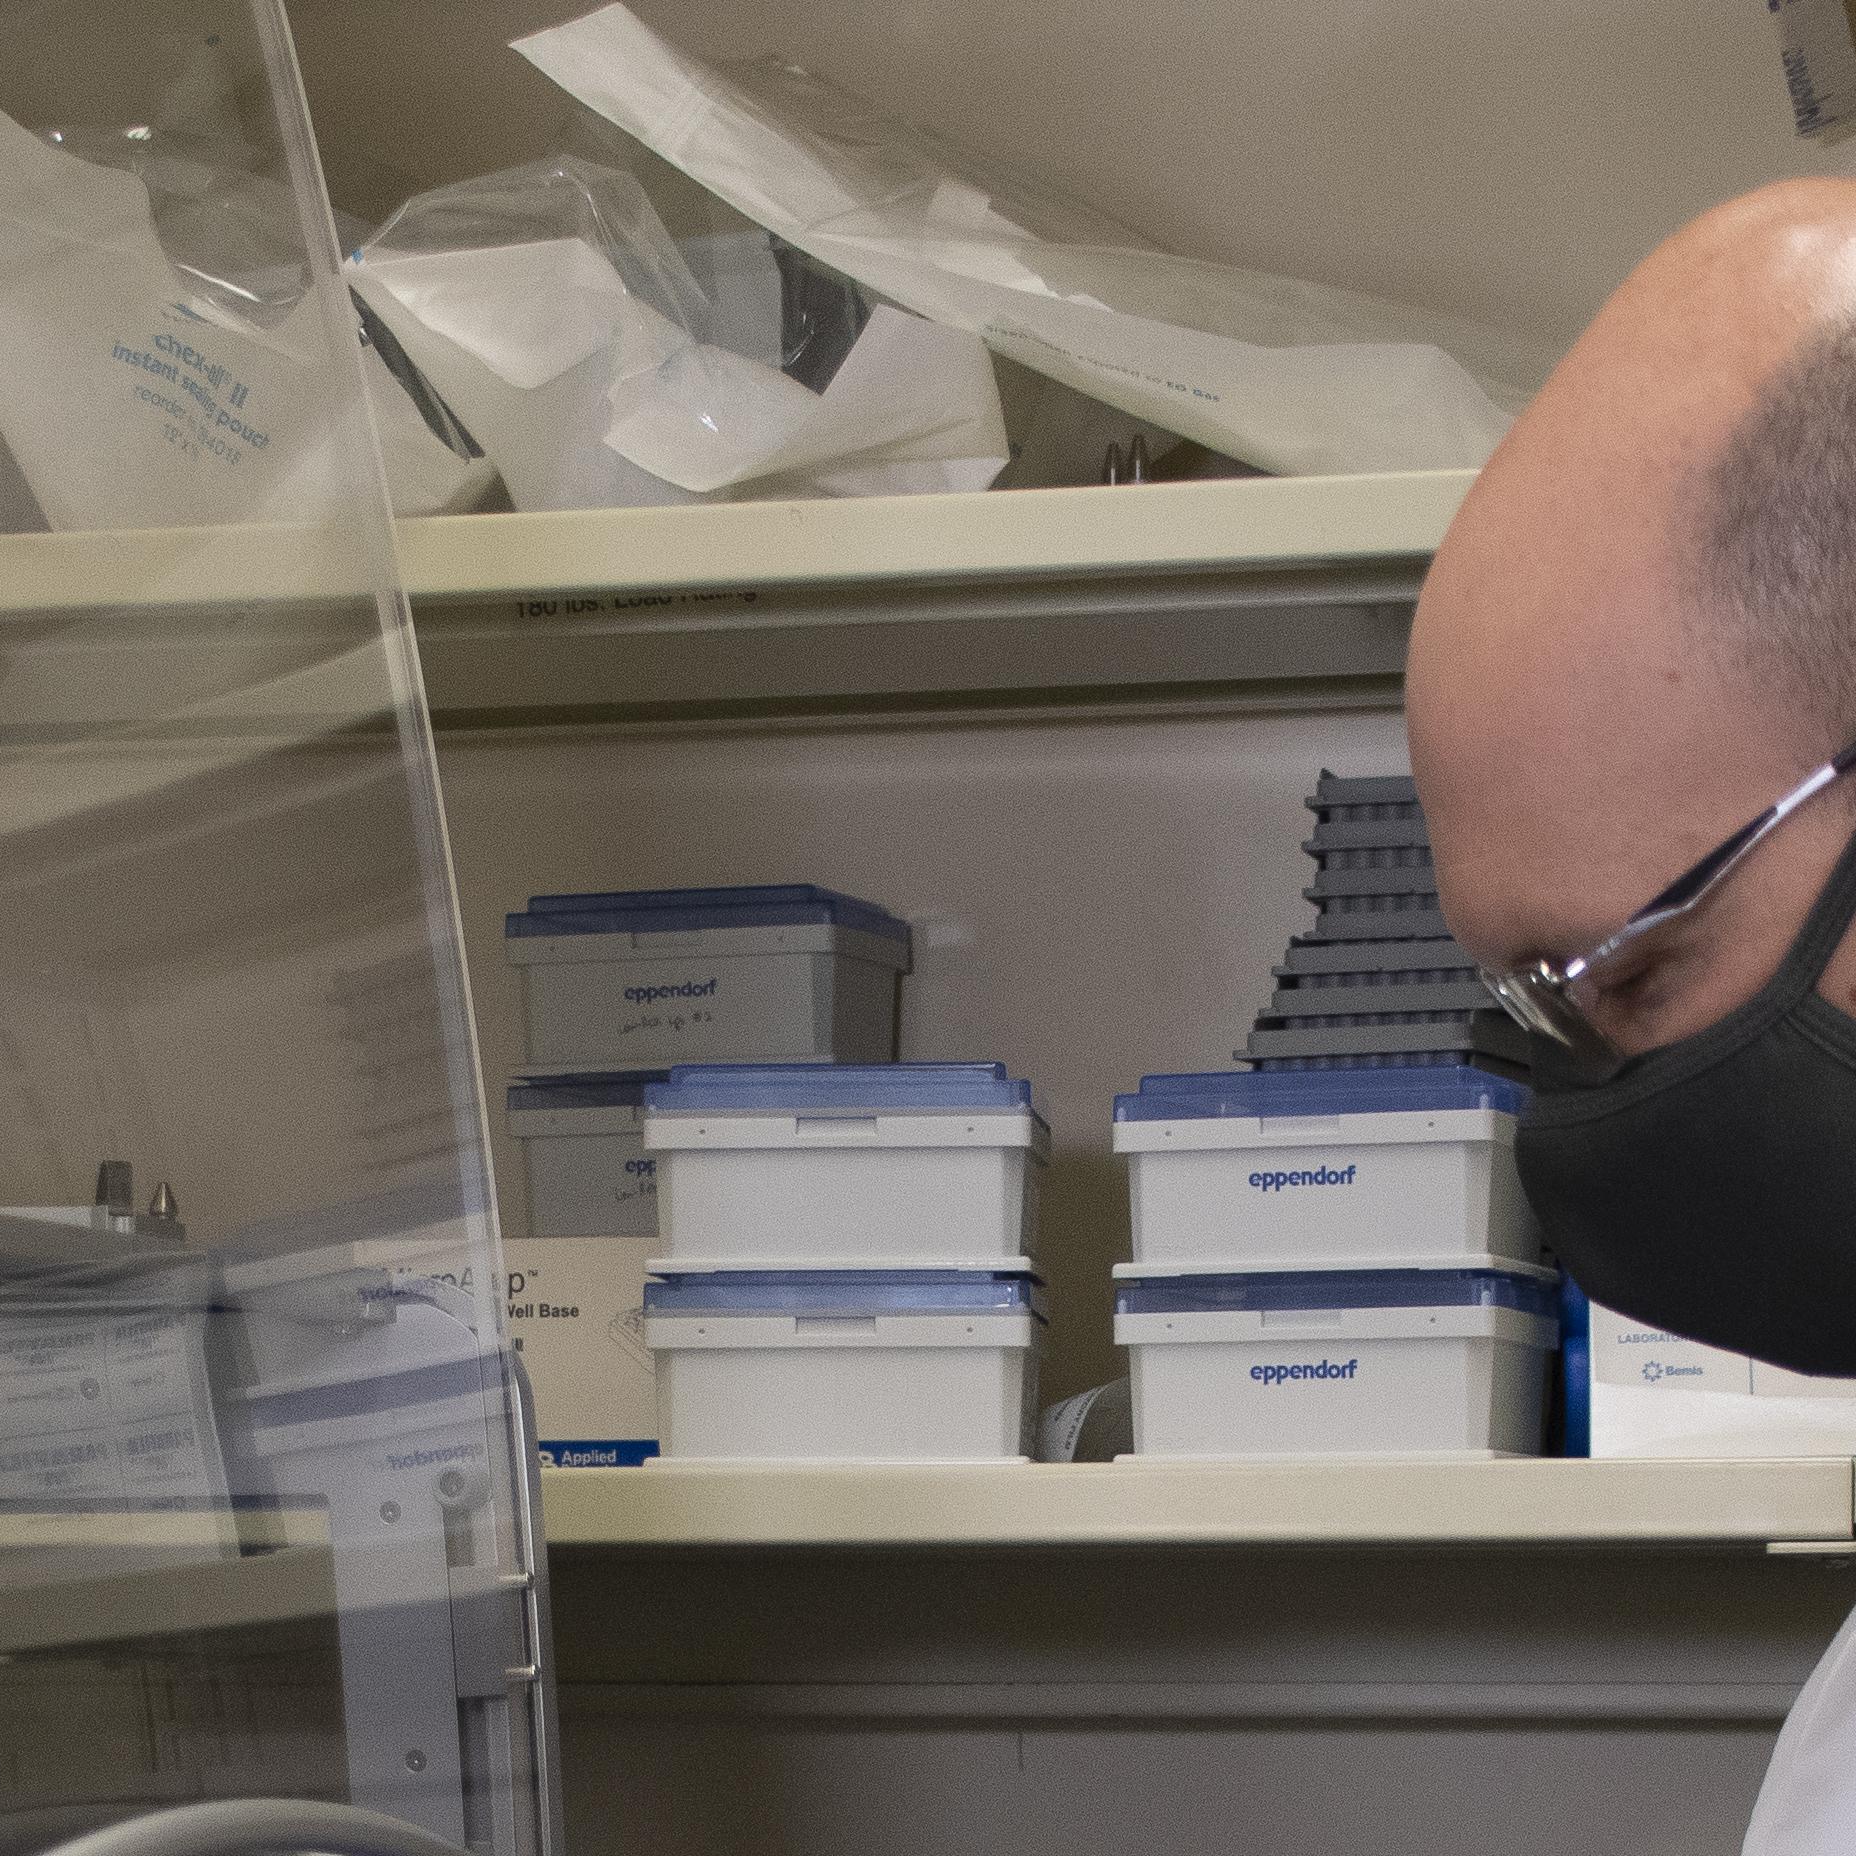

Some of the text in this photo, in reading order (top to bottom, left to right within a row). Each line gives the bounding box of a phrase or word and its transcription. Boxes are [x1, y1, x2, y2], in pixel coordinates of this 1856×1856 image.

[112, 339, 179, 383] instant
[624, 977, 717, 1005] eppendorf
[1248, 1164, 1356, 1193] eppendorf
[539, 1304, 580, 1319] Base
[1249, 1358, 1358, 1386] eppendorf
[1665, 1365, 1704, 1377] Bemis
[561, 1448, 617, 1466] Applied
